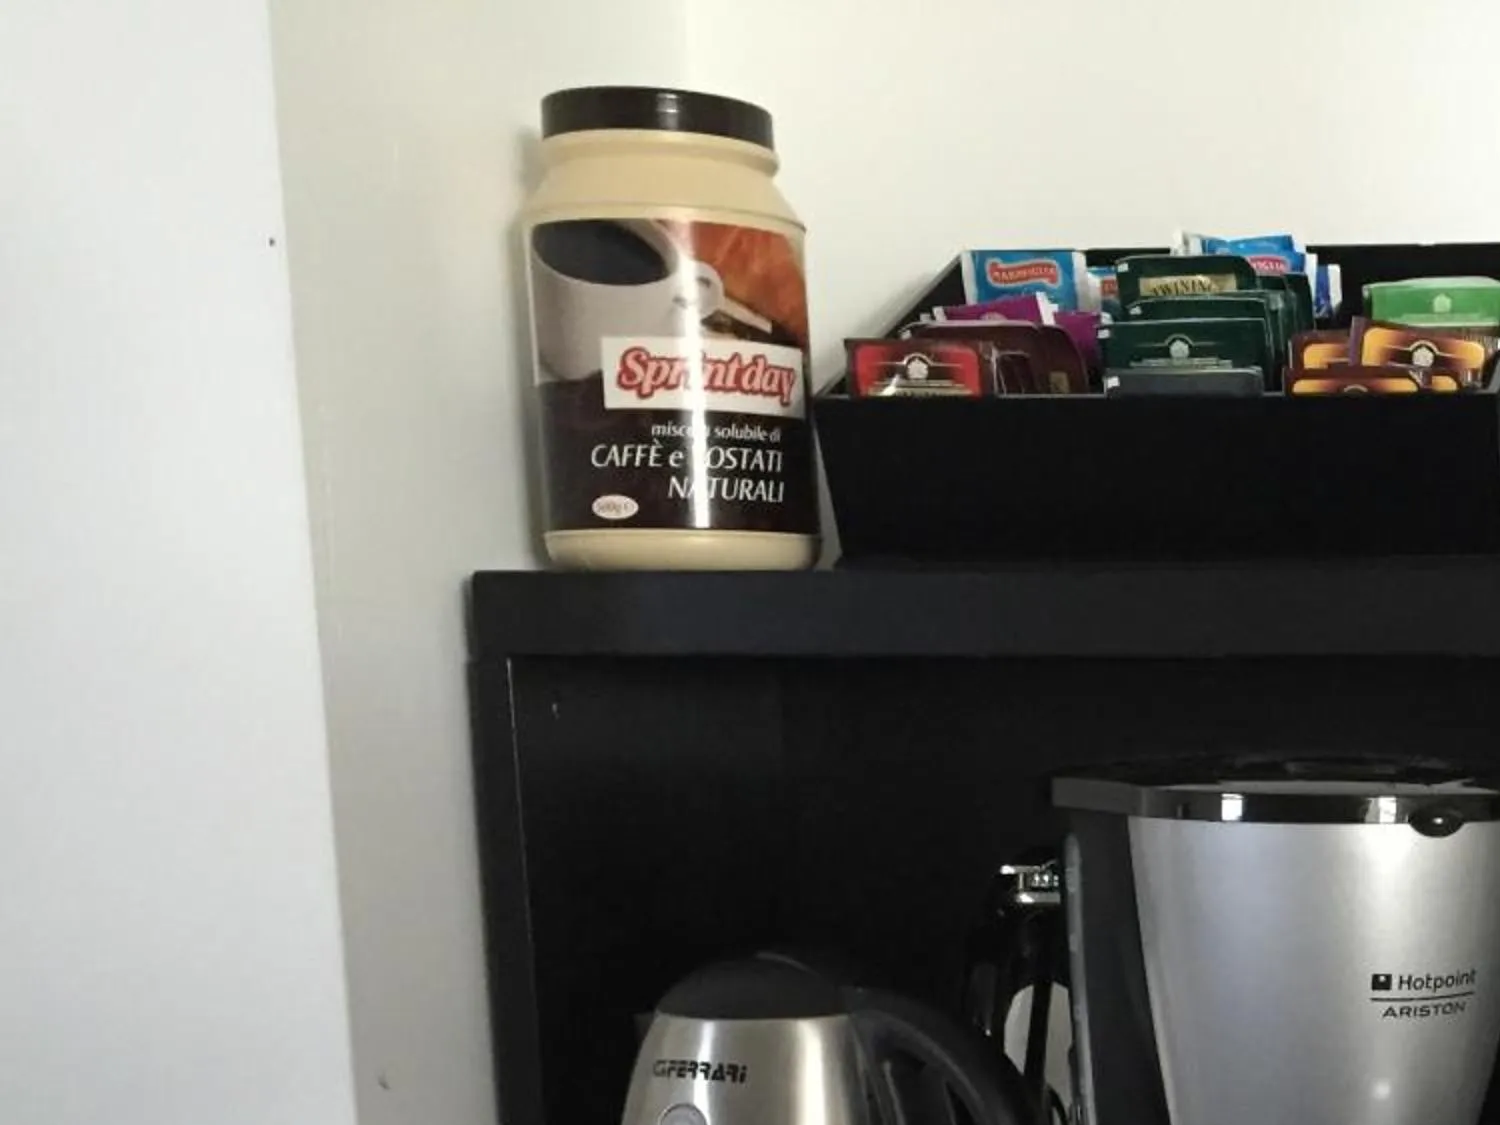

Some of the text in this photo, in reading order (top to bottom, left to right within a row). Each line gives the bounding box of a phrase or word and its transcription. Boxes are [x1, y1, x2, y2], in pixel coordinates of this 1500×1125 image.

[617, 346, 797, 408] Sprntday
[590, 438, 784, 473] CAFFÈ e OSTATI
[1398, 967, 1476, 993] Hotpoint
[1382, 1001, 1467, 1019] ARISTON
